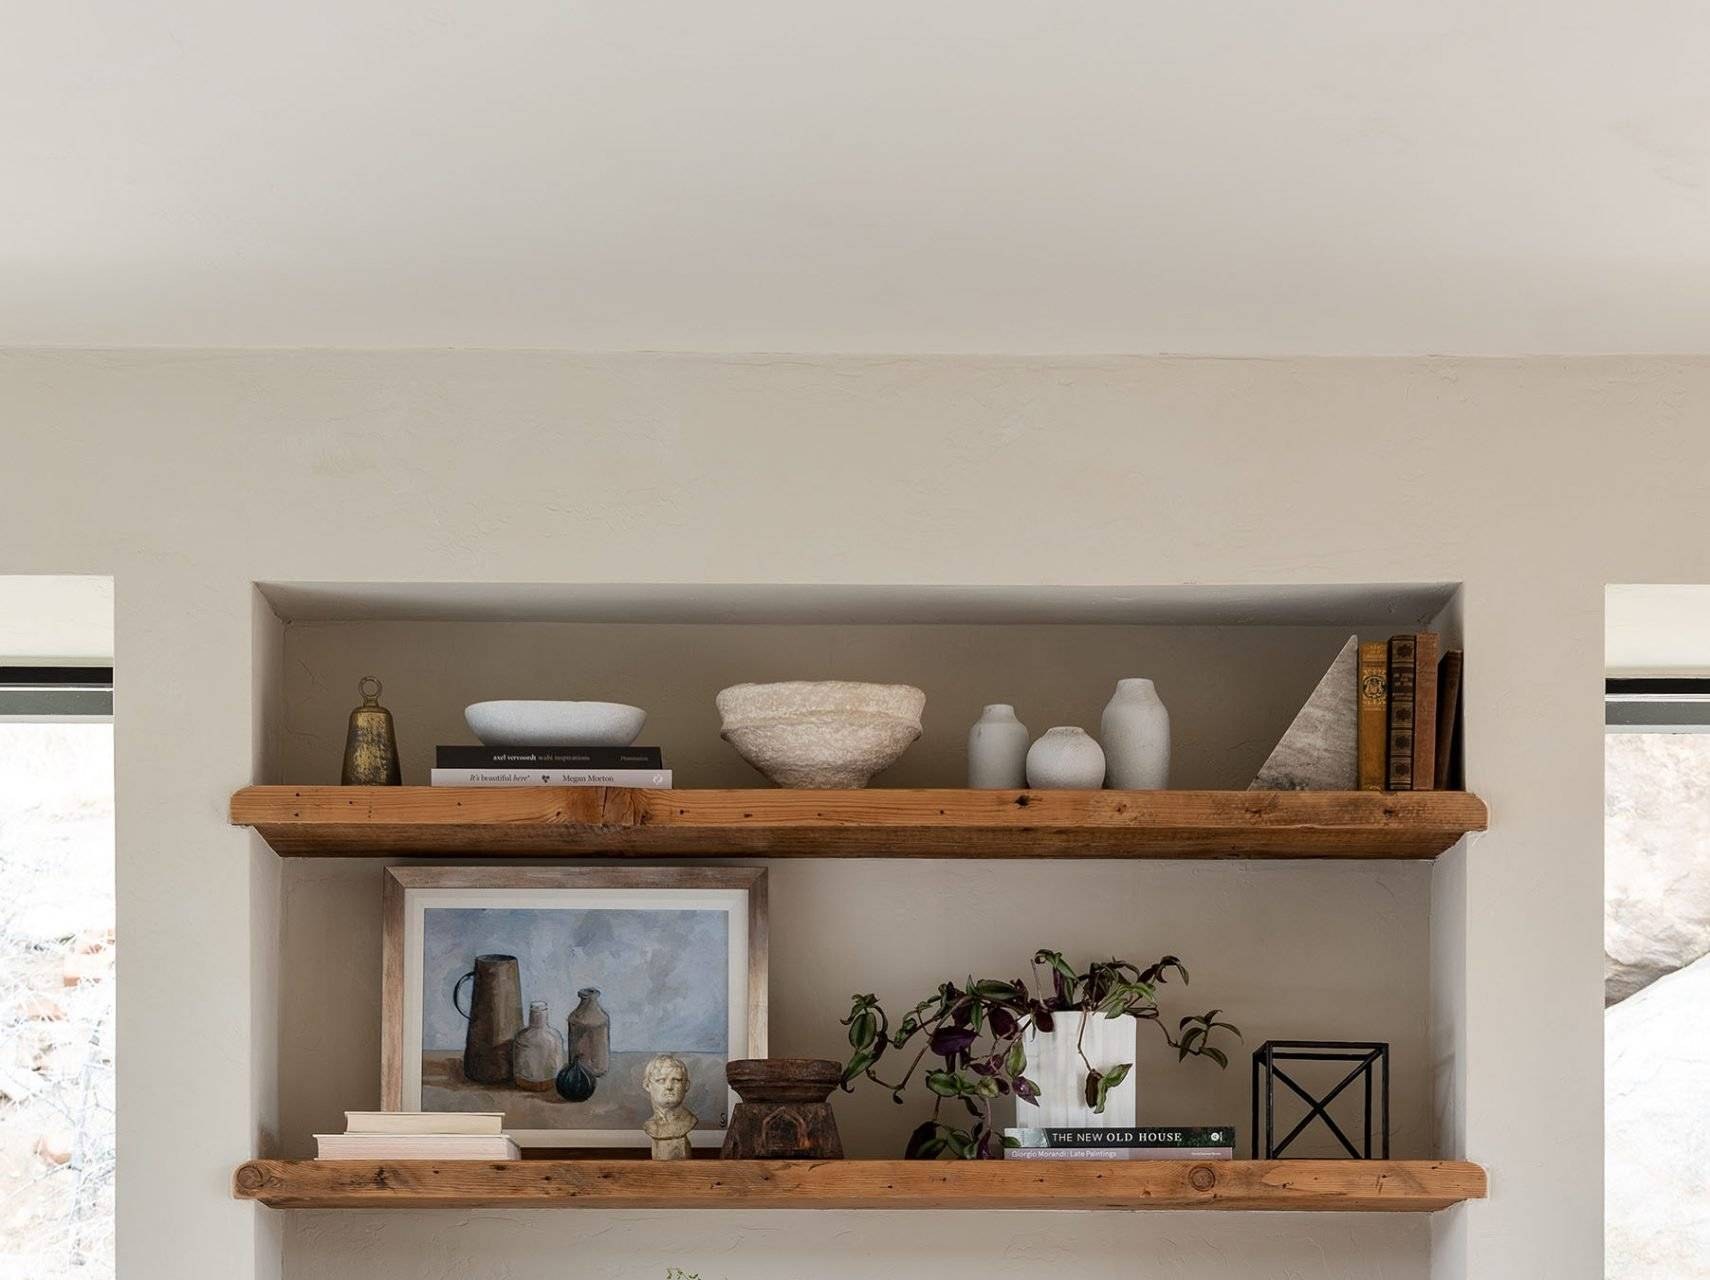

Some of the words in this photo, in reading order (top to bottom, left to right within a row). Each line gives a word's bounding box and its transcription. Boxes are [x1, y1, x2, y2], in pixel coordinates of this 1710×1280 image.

[562, 774, 588, 783] Megan
[588, 774, 614, 782] Morton
[1052, 1132, 1074, 1143] THE
[1076, 1132, 1103, 1143] NEW
[1106, 1132, 1133, 1143] OLD
[1139, 1132, 1182, 1143] HOUSE
